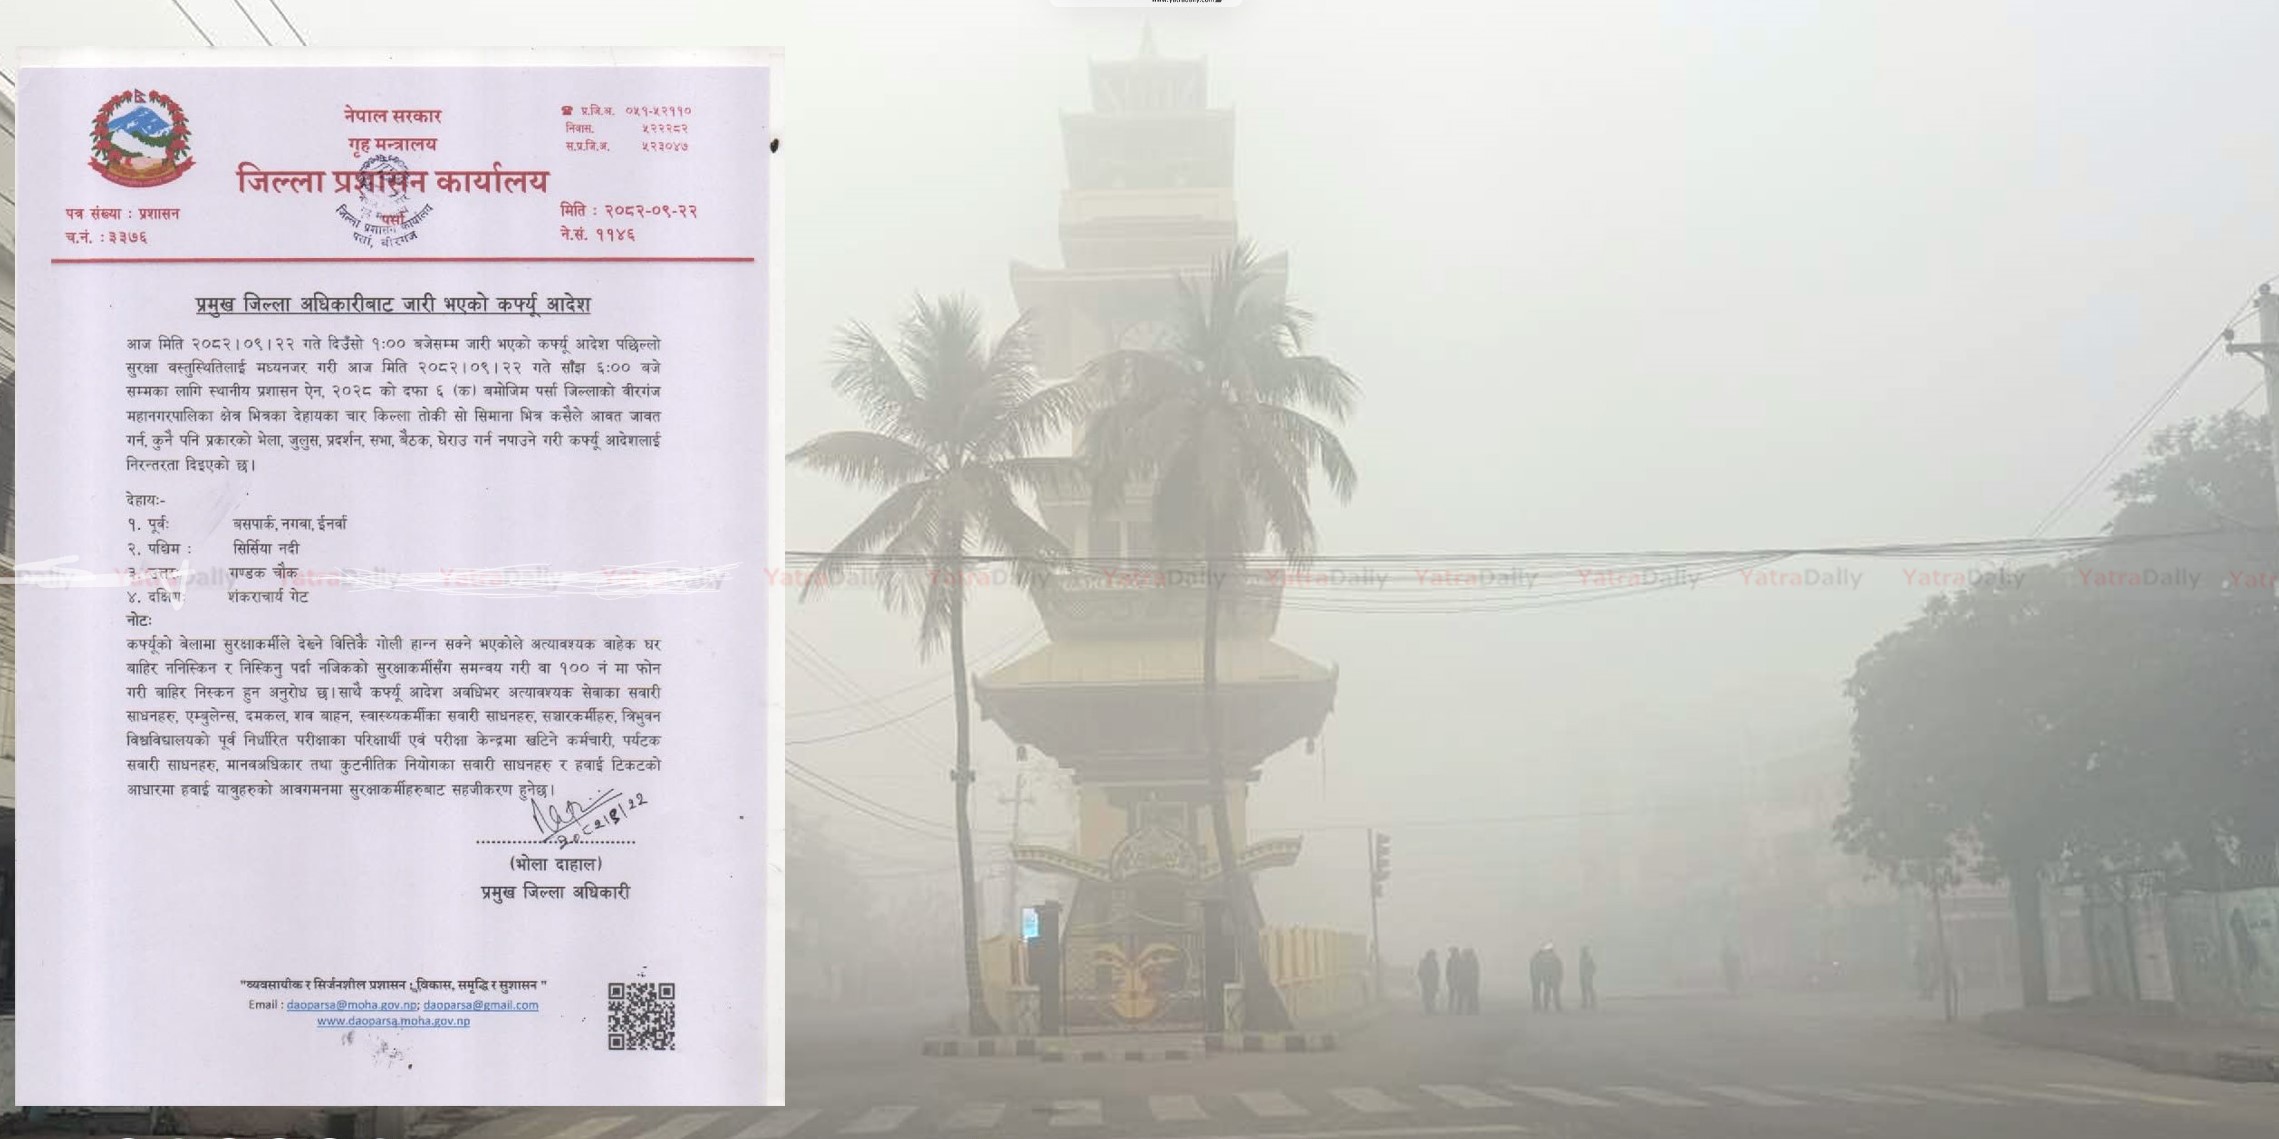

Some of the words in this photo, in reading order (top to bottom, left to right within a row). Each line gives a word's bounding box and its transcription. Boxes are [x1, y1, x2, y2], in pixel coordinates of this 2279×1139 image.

[344, 104, 389, 123] नेपाल
[392, 110, 443, 124] सरकार
[643, 124, 687, 133] ५२२२८२
[348, 138, 371, 159] गृह
[374, 138, 438, 152] मन्त्रालय
[643, 142, 688, 151] ५२३०४७
[235, 161, 327, 193] जिल्ला
[331, 170, 429, 194] प्रशासन
[434, 161, 551, 193] कार्यालय
[66, 209, 85, 220] पत्र
[89, 205, 122, 220] संख्या
[138, 208, 181, 220] प्रशासन
[560, 201, 587, 217] मिति
[605, 205, 696, 218] २०८२-०९-२२
[596, 229, 635, 242] ११४६
[194, 298, 236, 318] प्रमुख
[243, 291, 292, 315] जिल्ला
[301, 291, 395, 315] अधिकारीबाट
[401, 292, 437, 315] जारी
[444, 291, 490, 315] भएको
[495, 292, 538, 317] कर्फ्यू
[547, 292, 592, 315] आदेश
[127, 339, 152, 350] आज
[158, 335, 184, 350] मिति
[302, 334, 322, 350] गते
[372, 338, 405, 351] १:००
[413, 334, 460, 350] बजेसम्म
[465, 334, 492, 350] जारी
[497, 334, 532, 352] भएको
[537, 335, 571, 354] कर्फ्यू
[576, 335, 610, 350] आदेश
[615, 335, 662, 352] पछिल्लो
[126, 363, 159, 378] सुरक्षा
[167, 358, 247, 378] वस्तुस्थितिलाई
[316, 359, 338, 374] गरी
[348, 363, 373, 373] आज
[382, 358, 408, 373] मिति
[532, 358, 551, 373] गते
[597, 362, 630, 374] ६:००
[126, 386, 169, 398] सम्मका
[174, 382, 203, 397] लागि
[208, 383, 251, 397] स्थानीय
[256, 386, 299, 397] प्रशासन
[304, 381, 325, 399] ऐन,
[332, 385, 372, 398] २०२८
[402, 386, 428, 397] दफा
[564, 382, 616, 397] जिल्लाको
[621, 383, 662, 398] वीरगंज
[126, 406, 214, 423] महानगरपालिका
[220, 406, 242, 422] क्षेत्र
[248, 406, 287, 422] भित्रका
[293, 406, 339, 423] देहायका
[345, 411, 367, 423] चार
[373, 406, 412, 422] किल्ला
[418, 406, 447, 422] तोकी
[475, 406, 513, 422] सिमाना
[549, 405, 584, 422] कसैले
[151, 429, 174, 451] कुनै
[179, 430, 200, 446] पनि
[205, 430, 252, 446] प्रकारको
[326, 431, 365, 448] प्रदर्शन,
[437, 431, 468, 447] घेराउ
[498, 431, 537, 447] नपाउने
[542, 431, 563, 446] गरी
[568, 431, 601, 450] कर्फ्यू
[606, 431, 662, 448] आदेशलाई
[126, 455, 180, 472] निरन्तरता
[185, 455, 230, 473] दिइएको
[127, 518, 141, 532] १.
[232, 515, 279, 532] बसपार्क,
[128, 543, 140, 556] २.
[148, 539, 181, 554] पश्चिम
[278, 540, 300, 555] नदी
[229, 568, 267, 579] गण्डक
[272, 561, 299, 579] चौक
[127, 591, 141, 604] ४.
[228, 588, 283, 603] शंकराचार्य
[289, 588, 309, 603] गेट
[126, 635, 173, 654] कर्फ्यूको
[223, 635, 290, 655] सुरक्षाकर्मीले
[376, 635, 403, 650] गोली
[444, 635, 472, 650] सक्ने
[479, 635, 524, 652] भएकोले
[318, 658, 369, 674] नजिकको
[459, 663, 503, 675] समन्वय
[560, 662, 589, 675] १००
[635, 659, 662, 674] फोन
[194, 683, 235, 698] निस्कन
[269, 683, 308, 703] अनुरोध
[410, 683, 444, 698] आदेश
[126, 711, 178, 724] साधनहरु,
[245, 711, 289, 723] दमकल,
[621, 707, 661, 727] त्रिभुवन
[126, 731, 211, 746] विश्वविद्यालयको
[296, 731, 347, 747] परीक्षाका
[476, 731, 517, 747] केन्द्रमा
[225, 755, 303, 771] मानवअधिकार
[309, 760, 333, 770] तथा
[611, 756, 662, 771] टिकटको
[128, 785, 175, 796] आधारमा
[451, 781, 513, 796] सहजीकरण
[510, 853, 548, 871] (भोला
[554, 856, 602, 872] दाहाल)
[480, 886, 517, 904] प्रमुख
[522, 881, 566, 899] जिल्ला
[573, 881, 631, 900] अधिकारी
[369, 980, 406, 991] प्रशासन
[499, 980, 538, 994] सुशासन
[249, 1000, 278, 1010] Email
[423, 1000, 539, 1012] daoparsa@gmail.com
[317, 1016, 471, 1029] www.daoparsa.moha.gov.np
